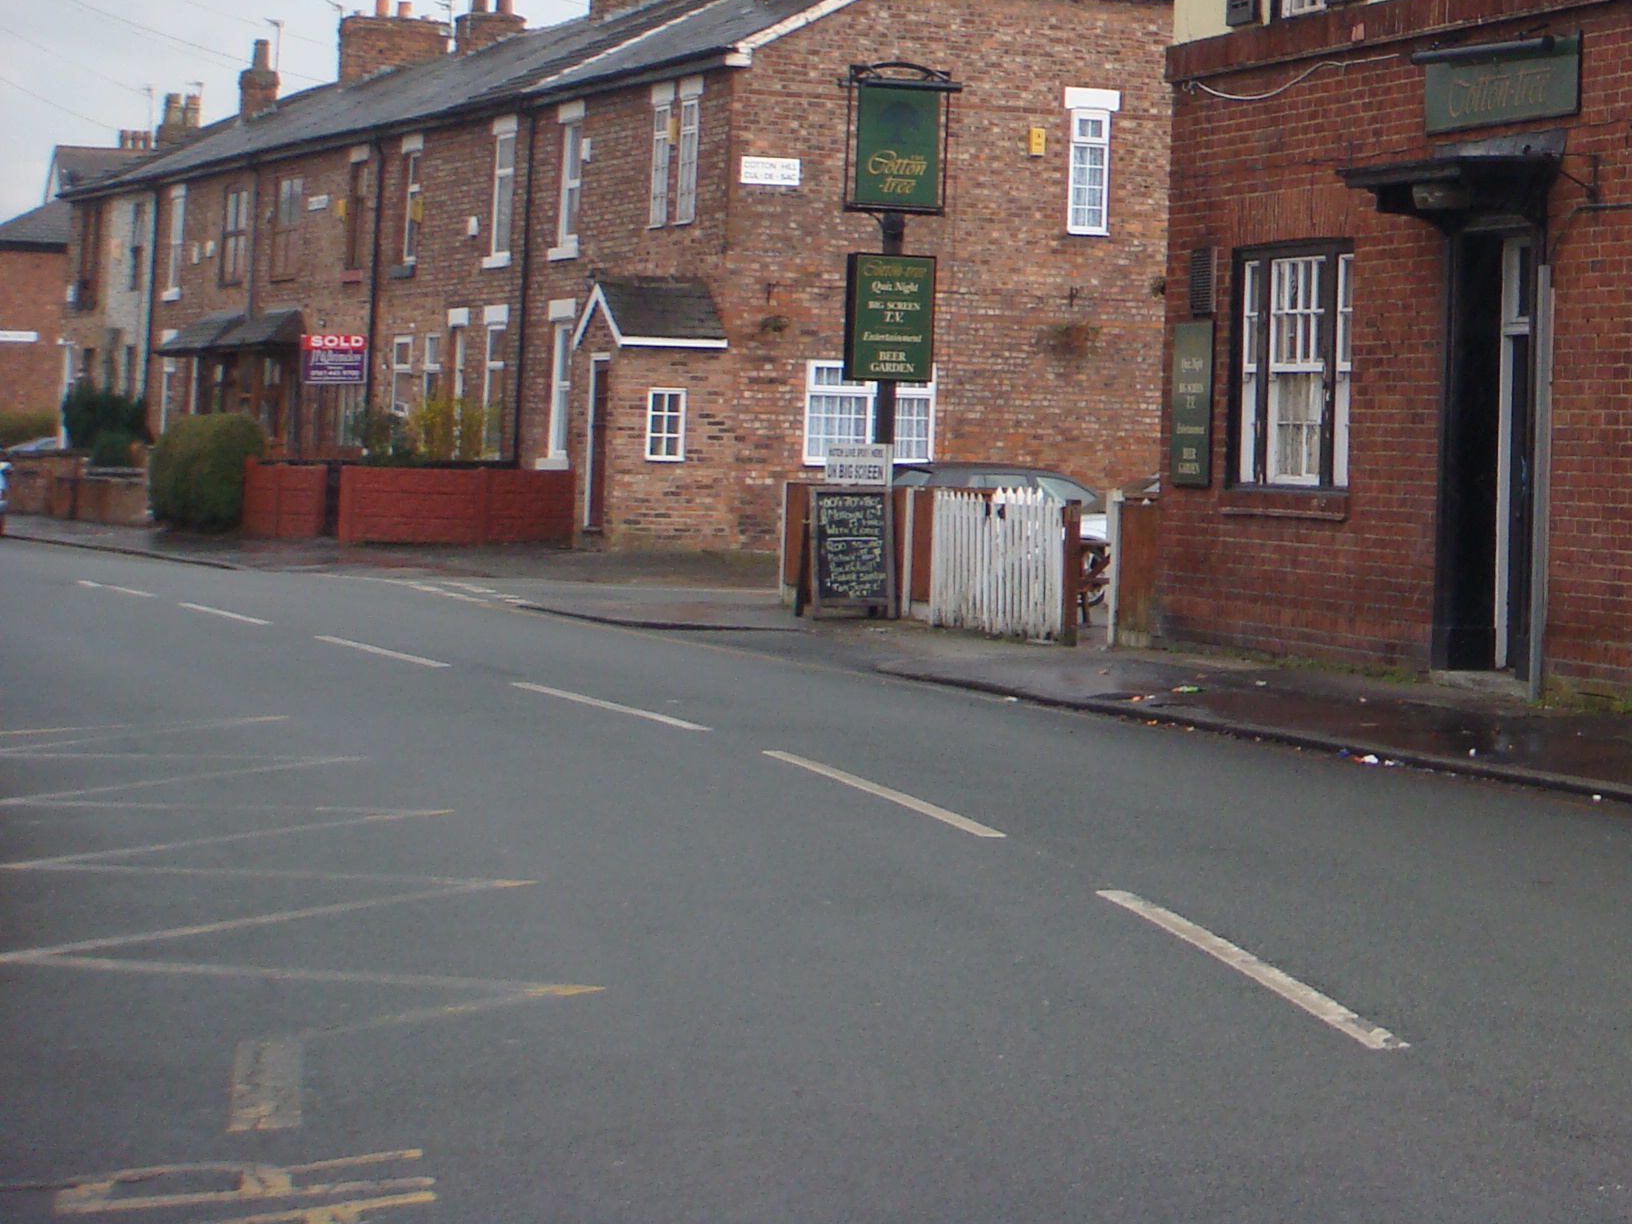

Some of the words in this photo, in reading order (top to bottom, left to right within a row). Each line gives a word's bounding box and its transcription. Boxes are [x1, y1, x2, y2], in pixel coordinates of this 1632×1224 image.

[868, 149, 927, 176] Cotton
[895, 282, 919, 294] Night
[868, 300, 884, 310] BIG
[887, 301, 921, 311] SCREEN
[884, 311, 904, 323] T.V.
[311, 336, 364, 347] SOLD
[862, 332, 922, 342] Entertainment
[879, 351, 906, 361] BEER
[870, 363, 915, 373] GARDEN
[839, 464, 852, 478] BIG
